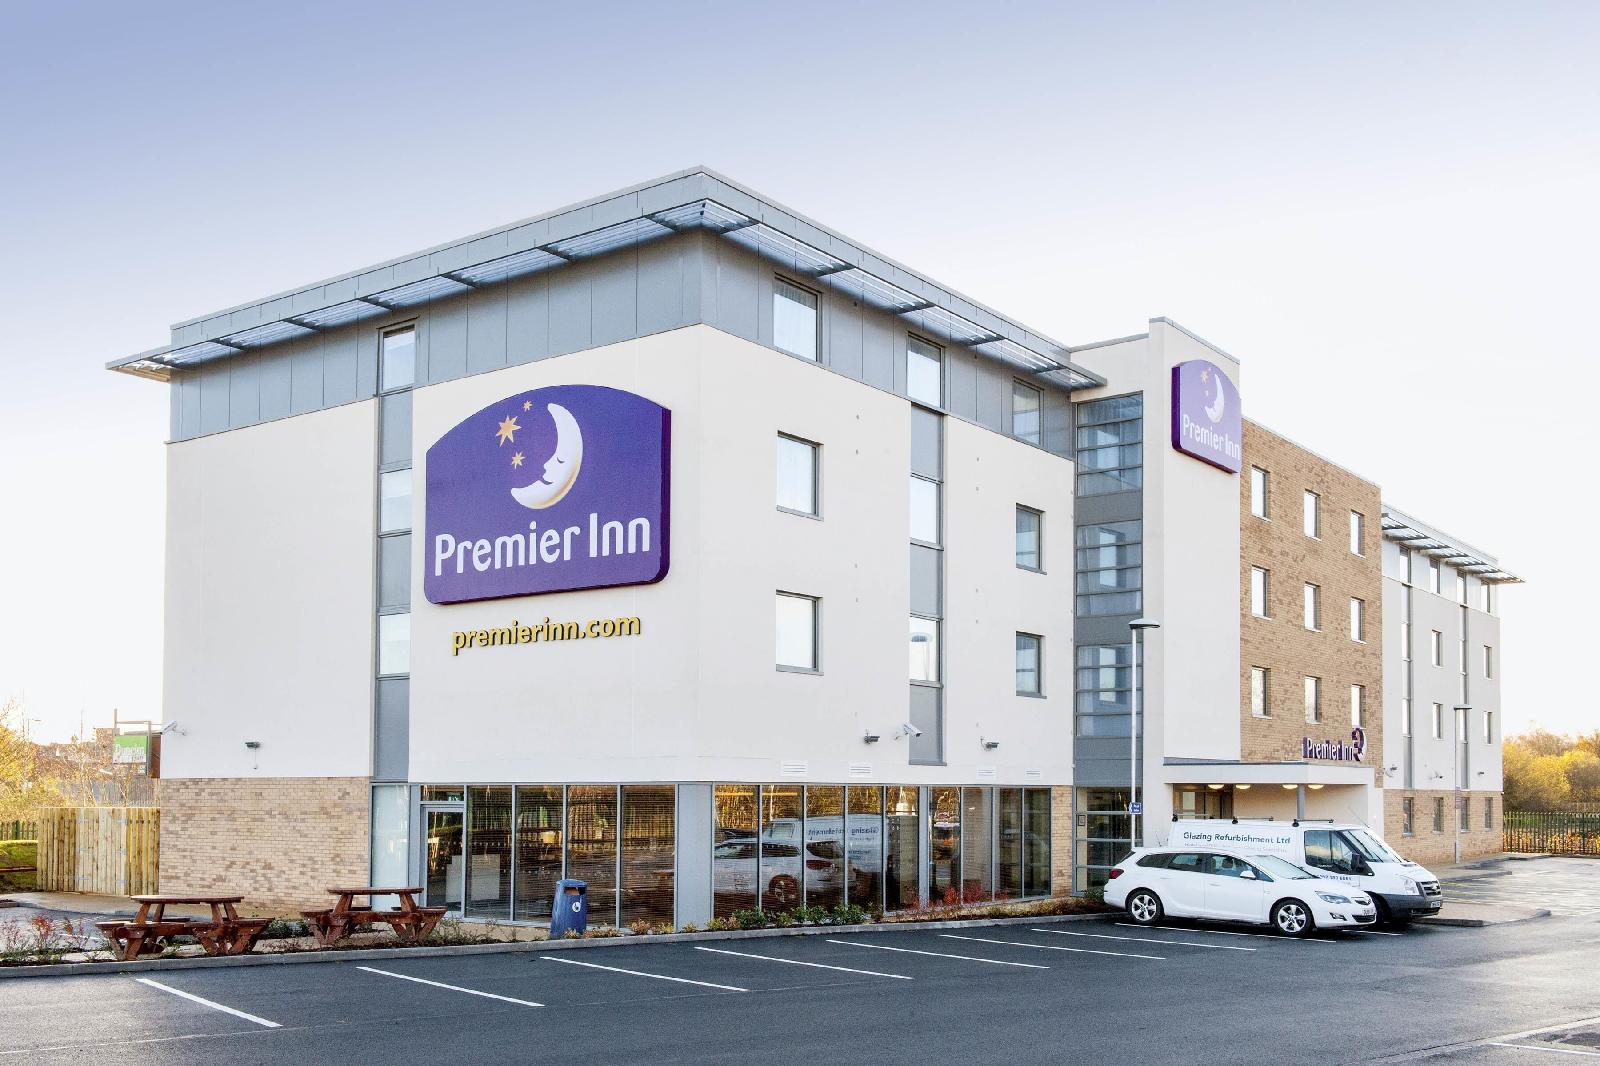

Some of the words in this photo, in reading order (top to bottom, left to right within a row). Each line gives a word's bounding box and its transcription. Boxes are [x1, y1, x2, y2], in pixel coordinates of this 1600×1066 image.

[1183, 414, 1224, 452] Premier
[1225, 433, 1240, 461] Inn
[435, 520, 580, 576] Premier
[589, 513, 650, 557] Inn
[452, 616, 641, 656] premierinn.com
[1303, 737, 1339, 760] Premier
[1338, 740, 1353, 761] Inn
[1183, 831, 1212, 842] Glazing
[1214, 833, 1274, 844] Refurbishment
[1276, 836, 1291, 845] Ltd
